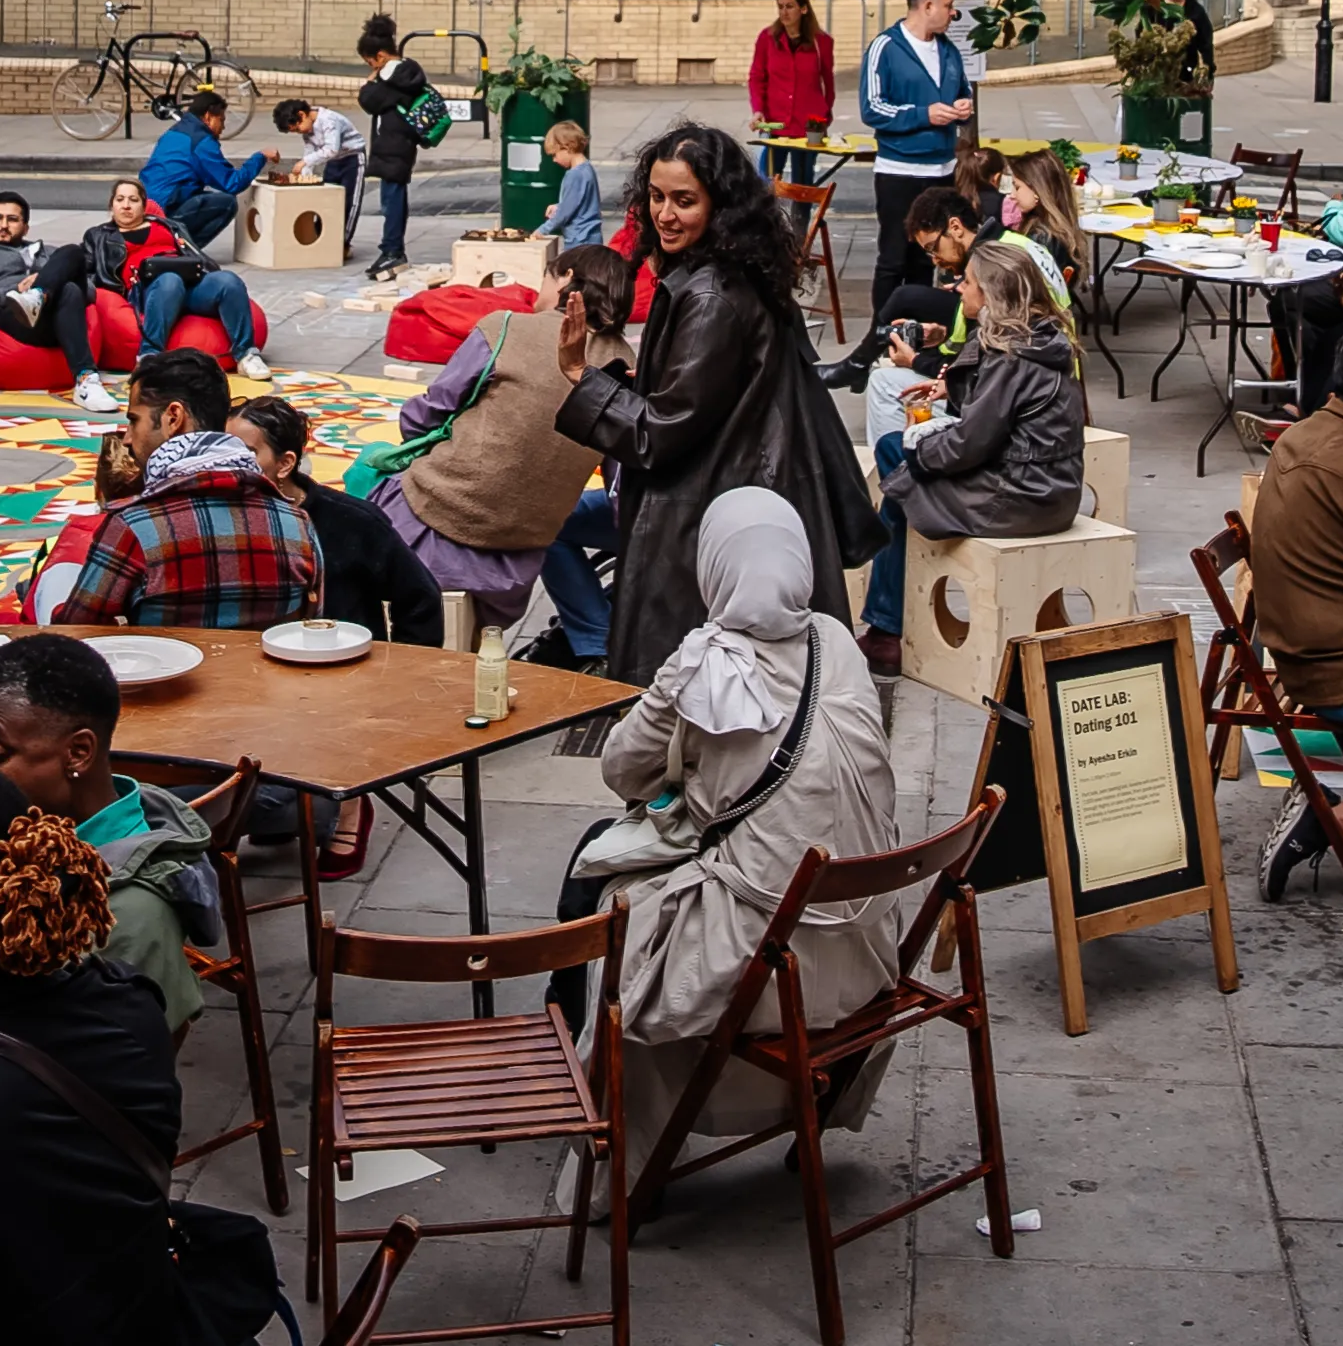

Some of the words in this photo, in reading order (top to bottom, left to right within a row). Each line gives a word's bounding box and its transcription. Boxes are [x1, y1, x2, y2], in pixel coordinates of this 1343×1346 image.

[1071, 695, 1102, 714] DATE
[1104, 691, 1132, 708] LAB:
[1073, 716, 1113, 736] Dating
[1115, 711, 1138, 728] 101
[1077, 759, 1087, 769] by
[1088, 752, 1116, 766] Ayesha
[1117, 748, 1138, 760] Erkin
